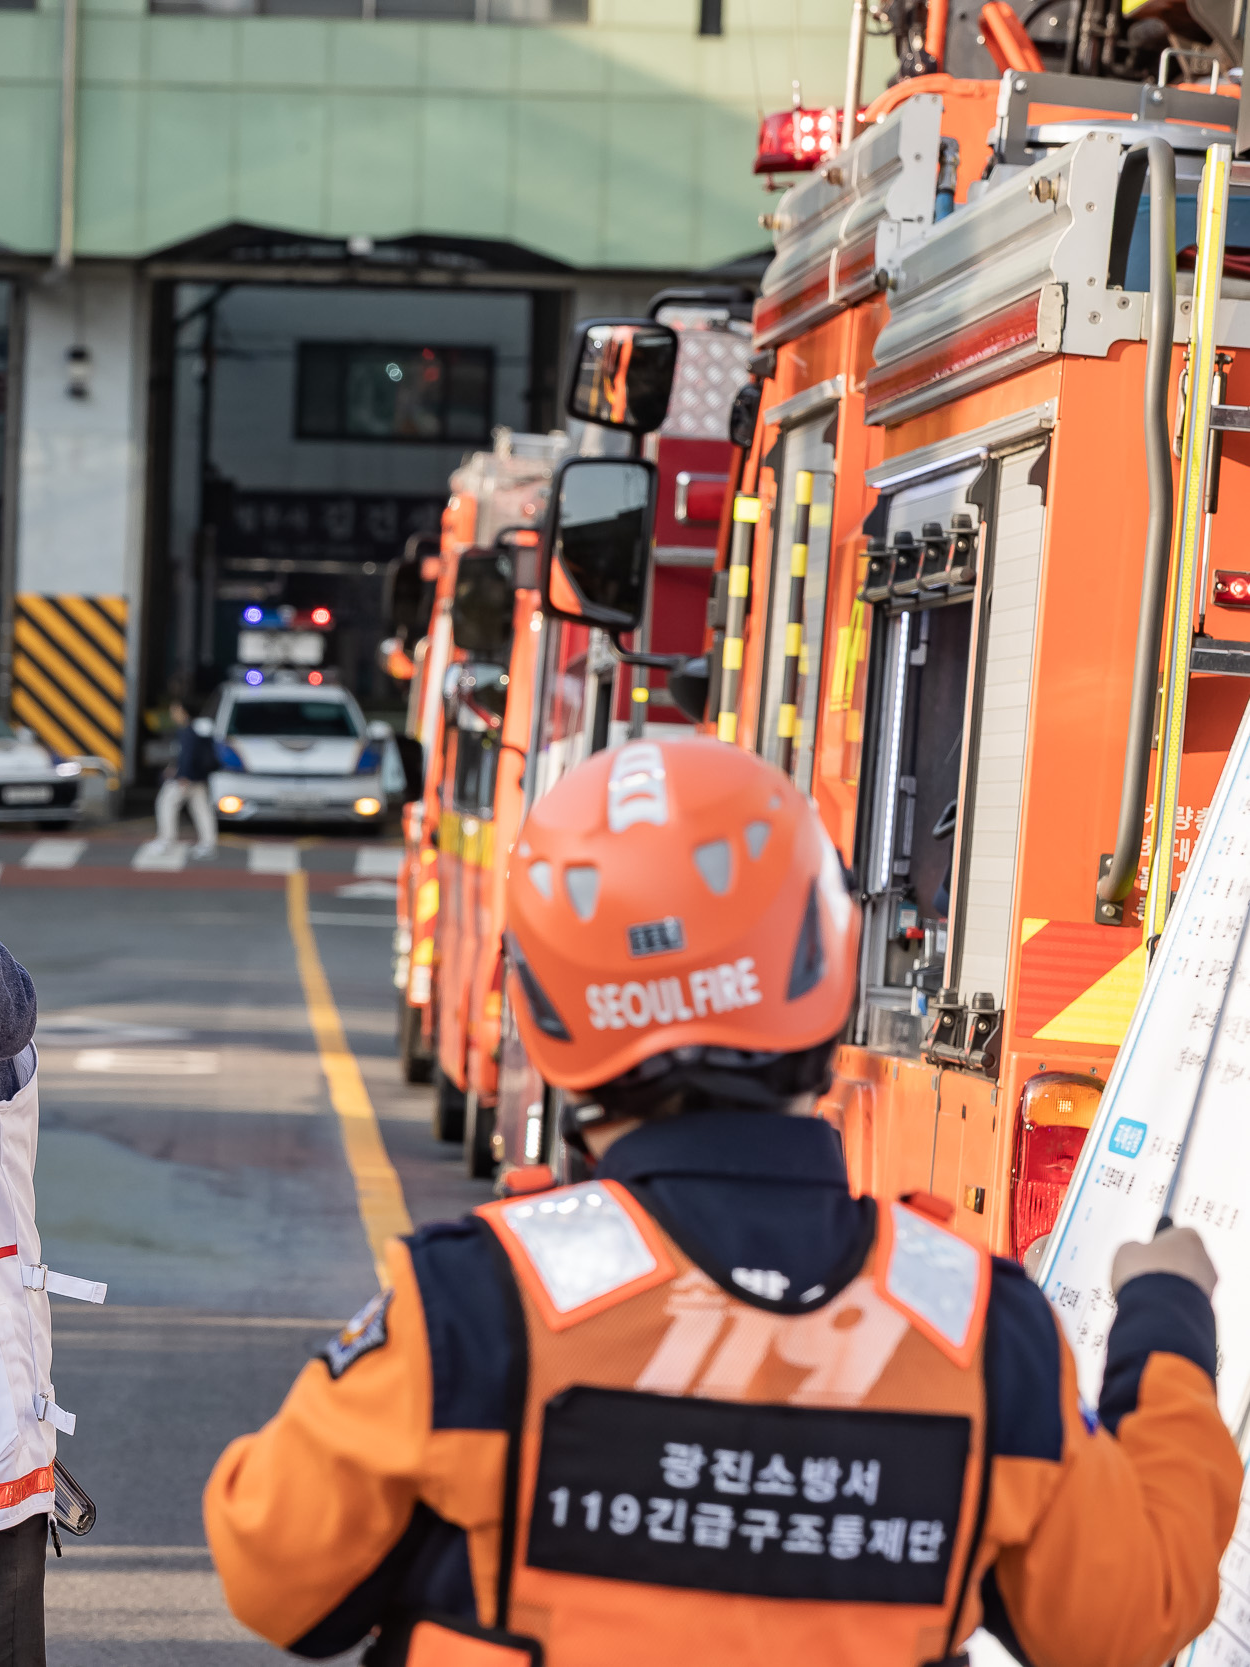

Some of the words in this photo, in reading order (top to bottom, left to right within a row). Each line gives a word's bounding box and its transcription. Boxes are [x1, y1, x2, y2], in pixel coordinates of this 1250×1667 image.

[585, 980, 694, 1031] SEOUL
[688, 956, 763, 1018] FIRE
[634, 1268, 910, 1408] 119
[658, 1440, 882, 1507] 광진소방서
[547, 1484, 948, 1565] 119긴급구조통제단
